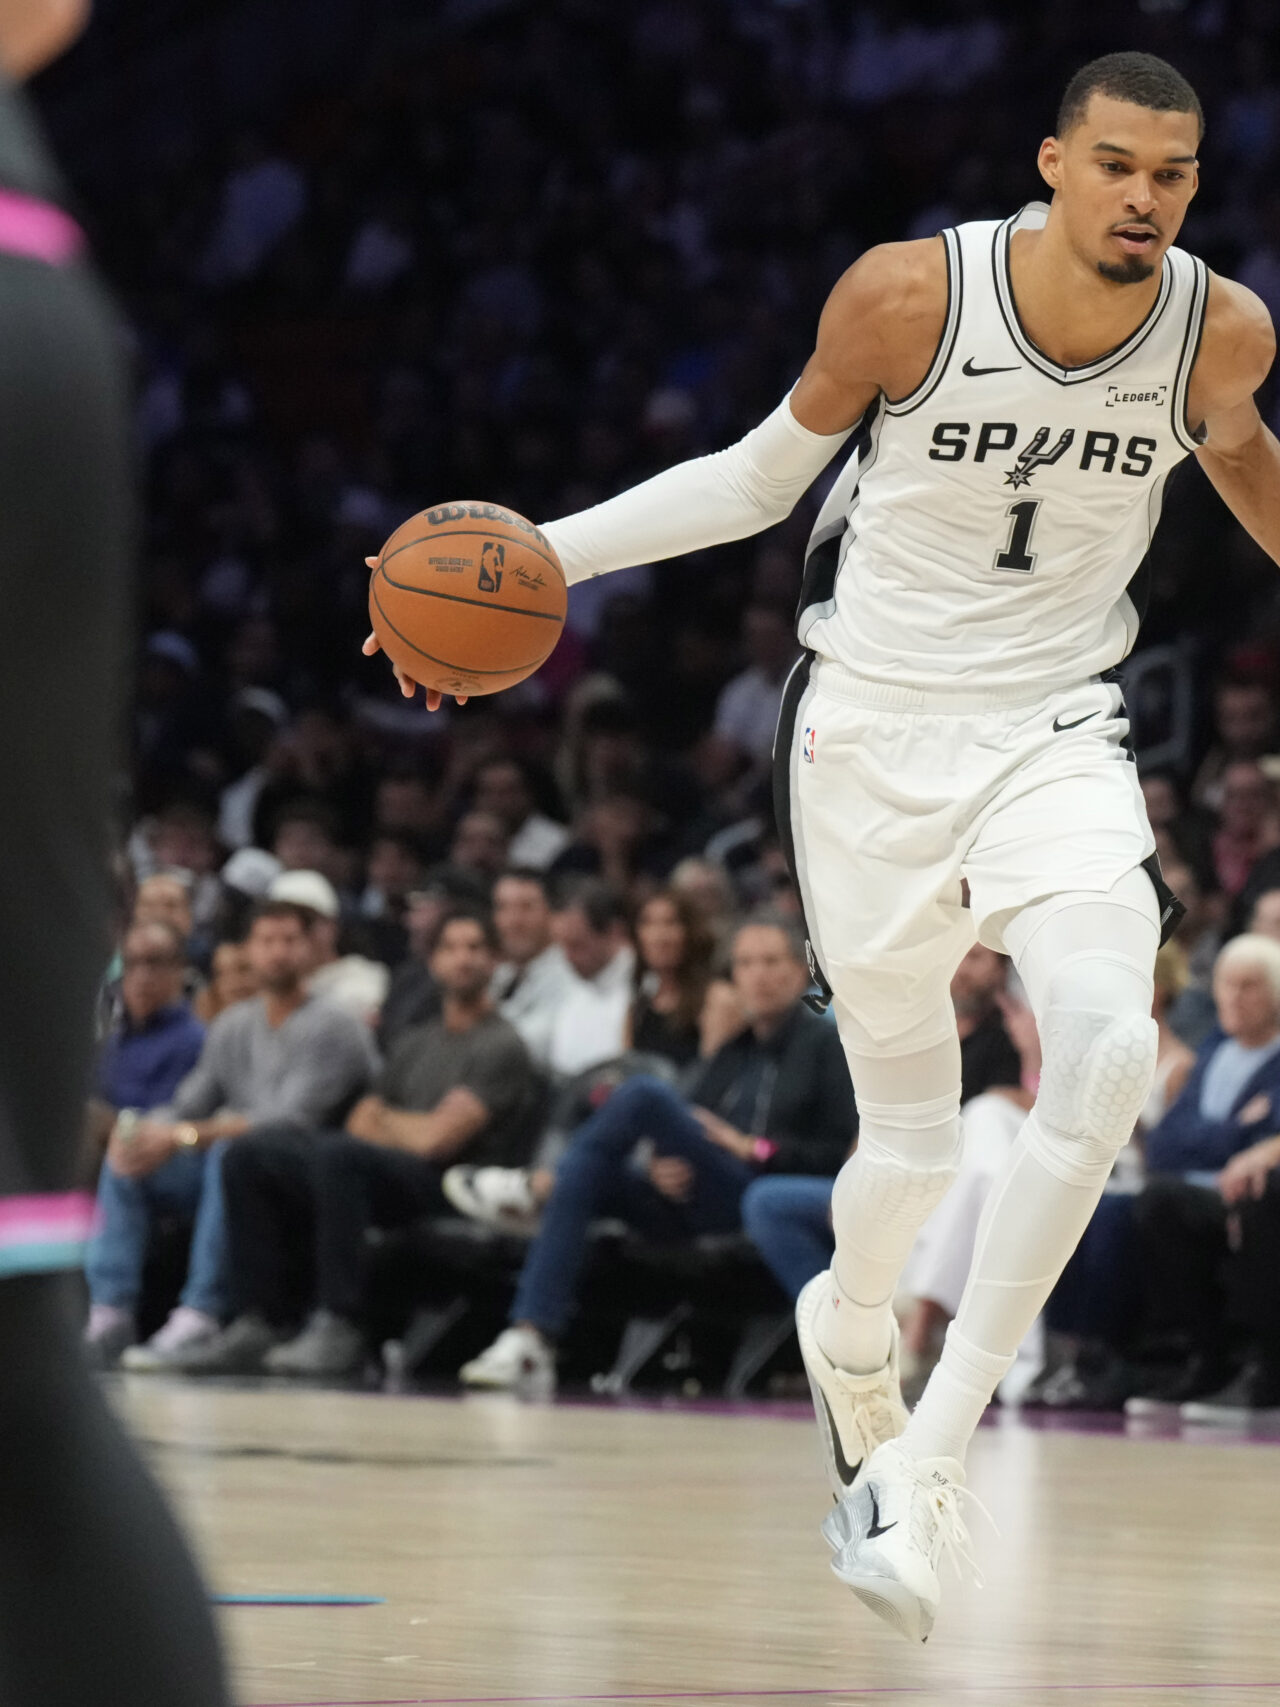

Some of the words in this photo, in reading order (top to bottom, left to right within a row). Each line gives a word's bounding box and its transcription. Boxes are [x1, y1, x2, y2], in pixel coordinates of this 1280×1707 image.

[1114, 391, 1159, 403] LEDGER
[928, 421, 1158, 491] SPURS
[992, 497, 1043, 575] 1
